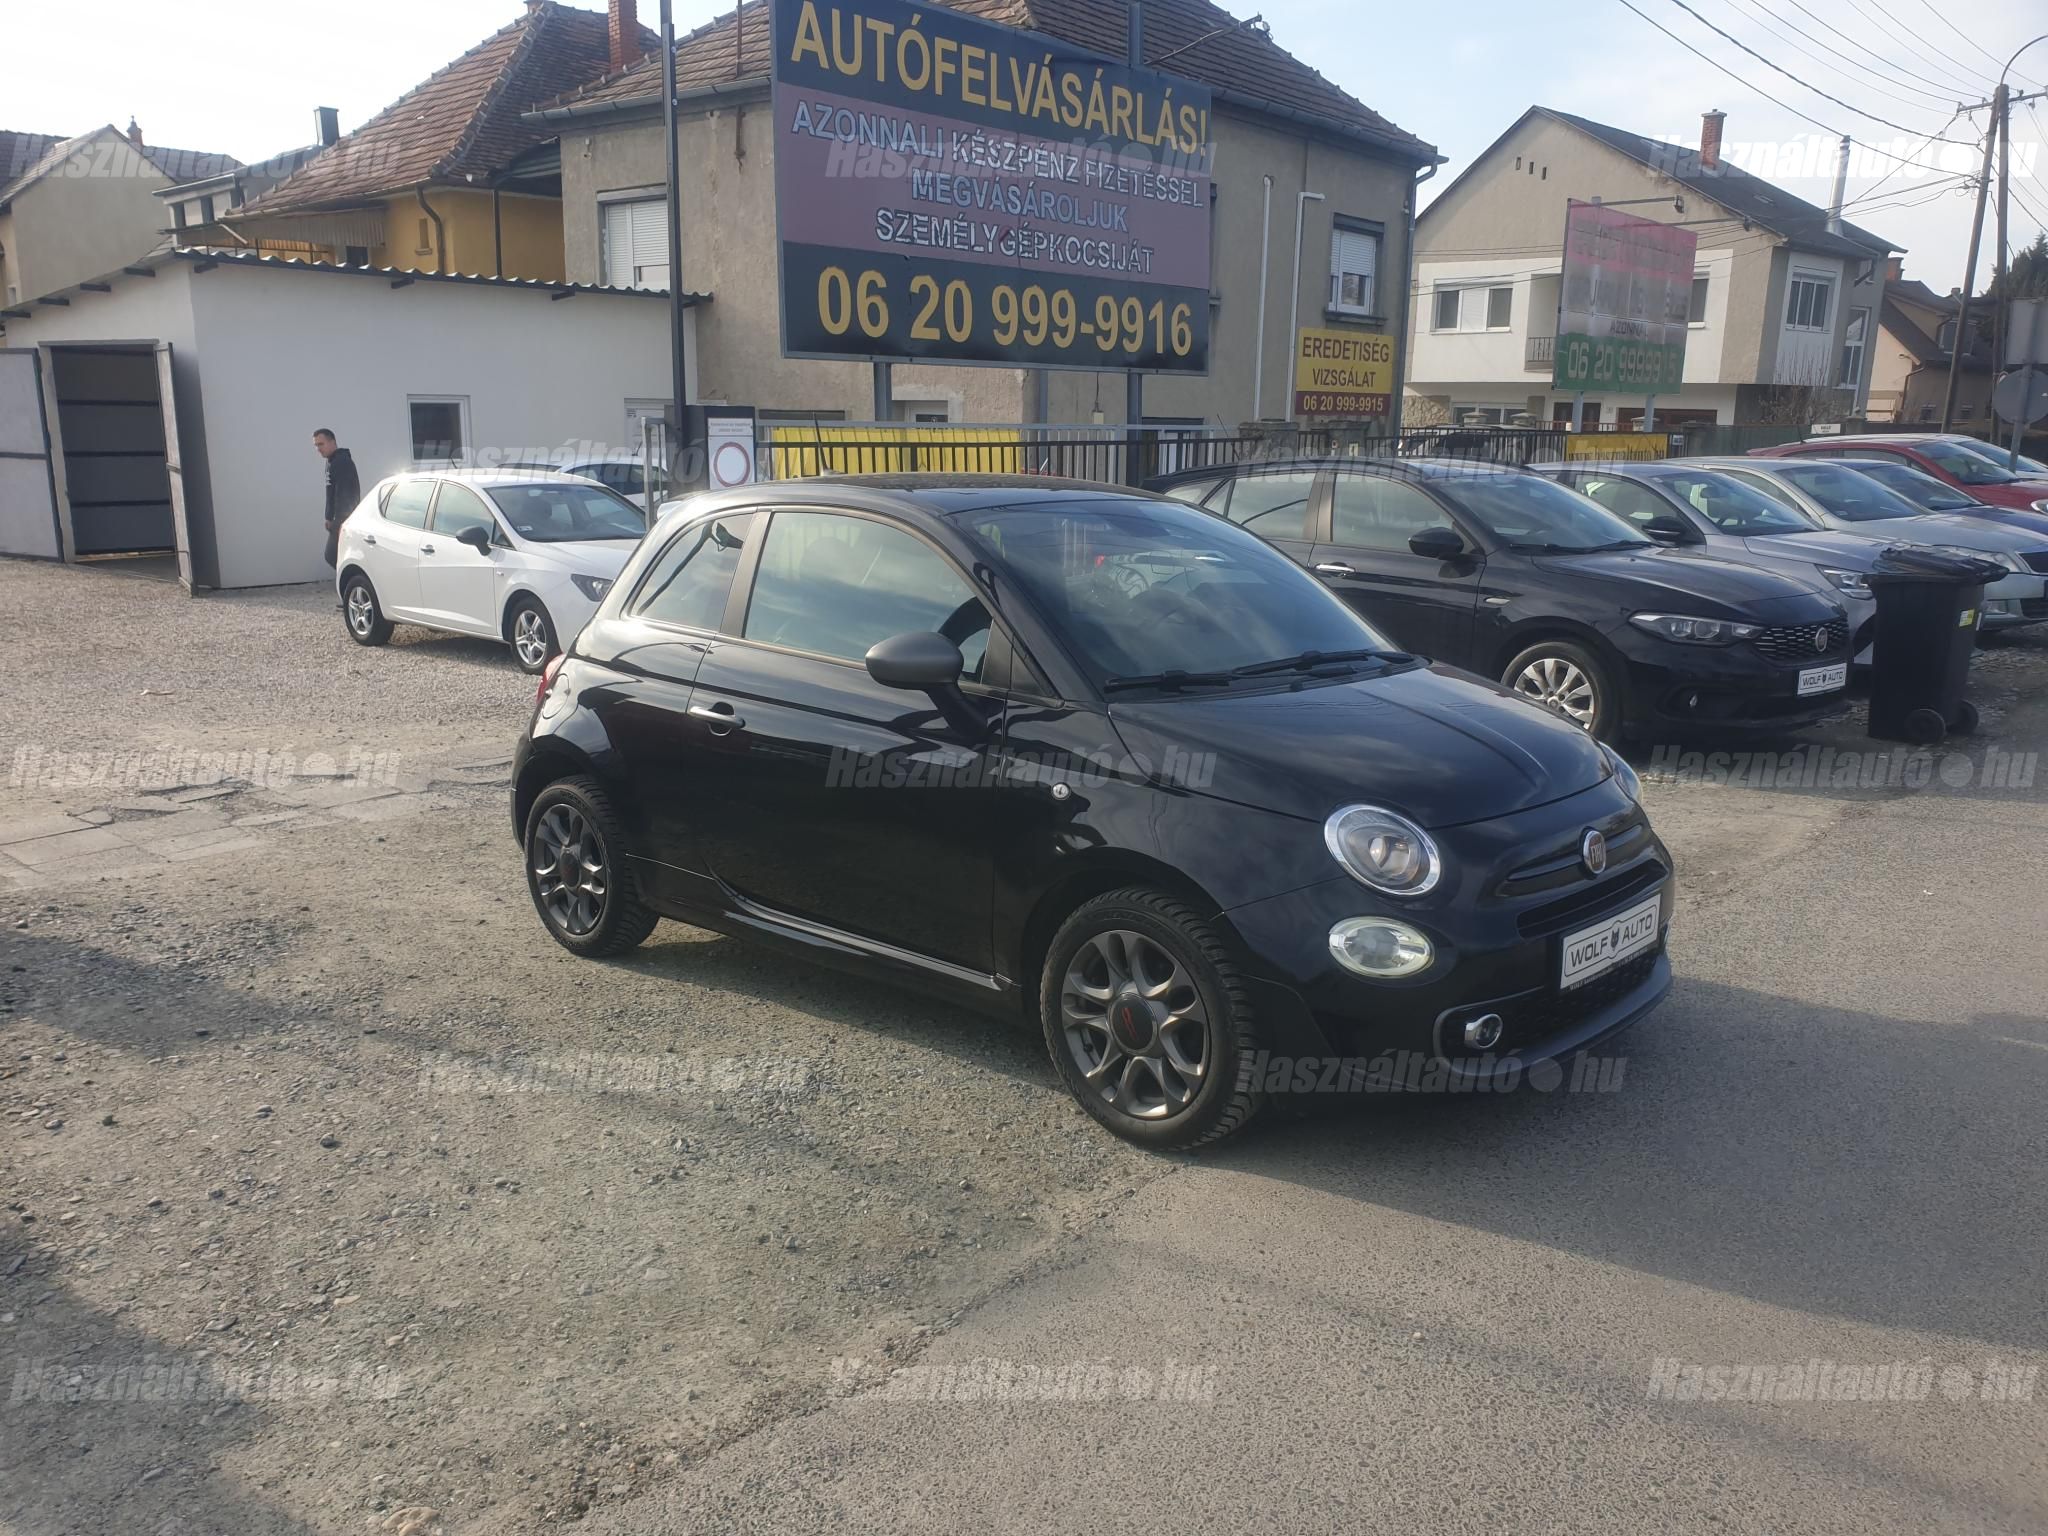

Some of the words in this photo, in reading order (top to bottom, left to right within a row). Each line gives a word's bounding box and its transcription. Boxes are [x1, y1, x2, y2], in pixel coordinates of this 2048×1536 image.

[791, 1, 1207, 157] AUTÓFELVÁSÁRLÁS!
[791, 100, 943, 158] AZONNALI
[952, 128, 1079, 183] KÉSZPÉNZ
[1085, 159, 1204, 207] FIZETÉSSEL
[911, 167, 1128, 232] MEGVÁSÁROLJUK
[817, 265, 889, 338] 06
[909, 274, 973, 343] 20
[991, 284, 1193, 357] 999-9916
[1303, 337, 1389, 362] EREDETISÉG
[1567, 342, 1590, 379] 06
[1593, 344, 1614, 380] 20
[1303, 395, 1317, 411] 06
[1320, 396, 1333, 411] 20
[1336, 396, 1383, 412] 999-9915
[1313, 366, 1376, 388] VIZSGÁLAT
[1571, 936, 1608, 967] WOLF
[1622, 913, 1653, 944] AUTO
